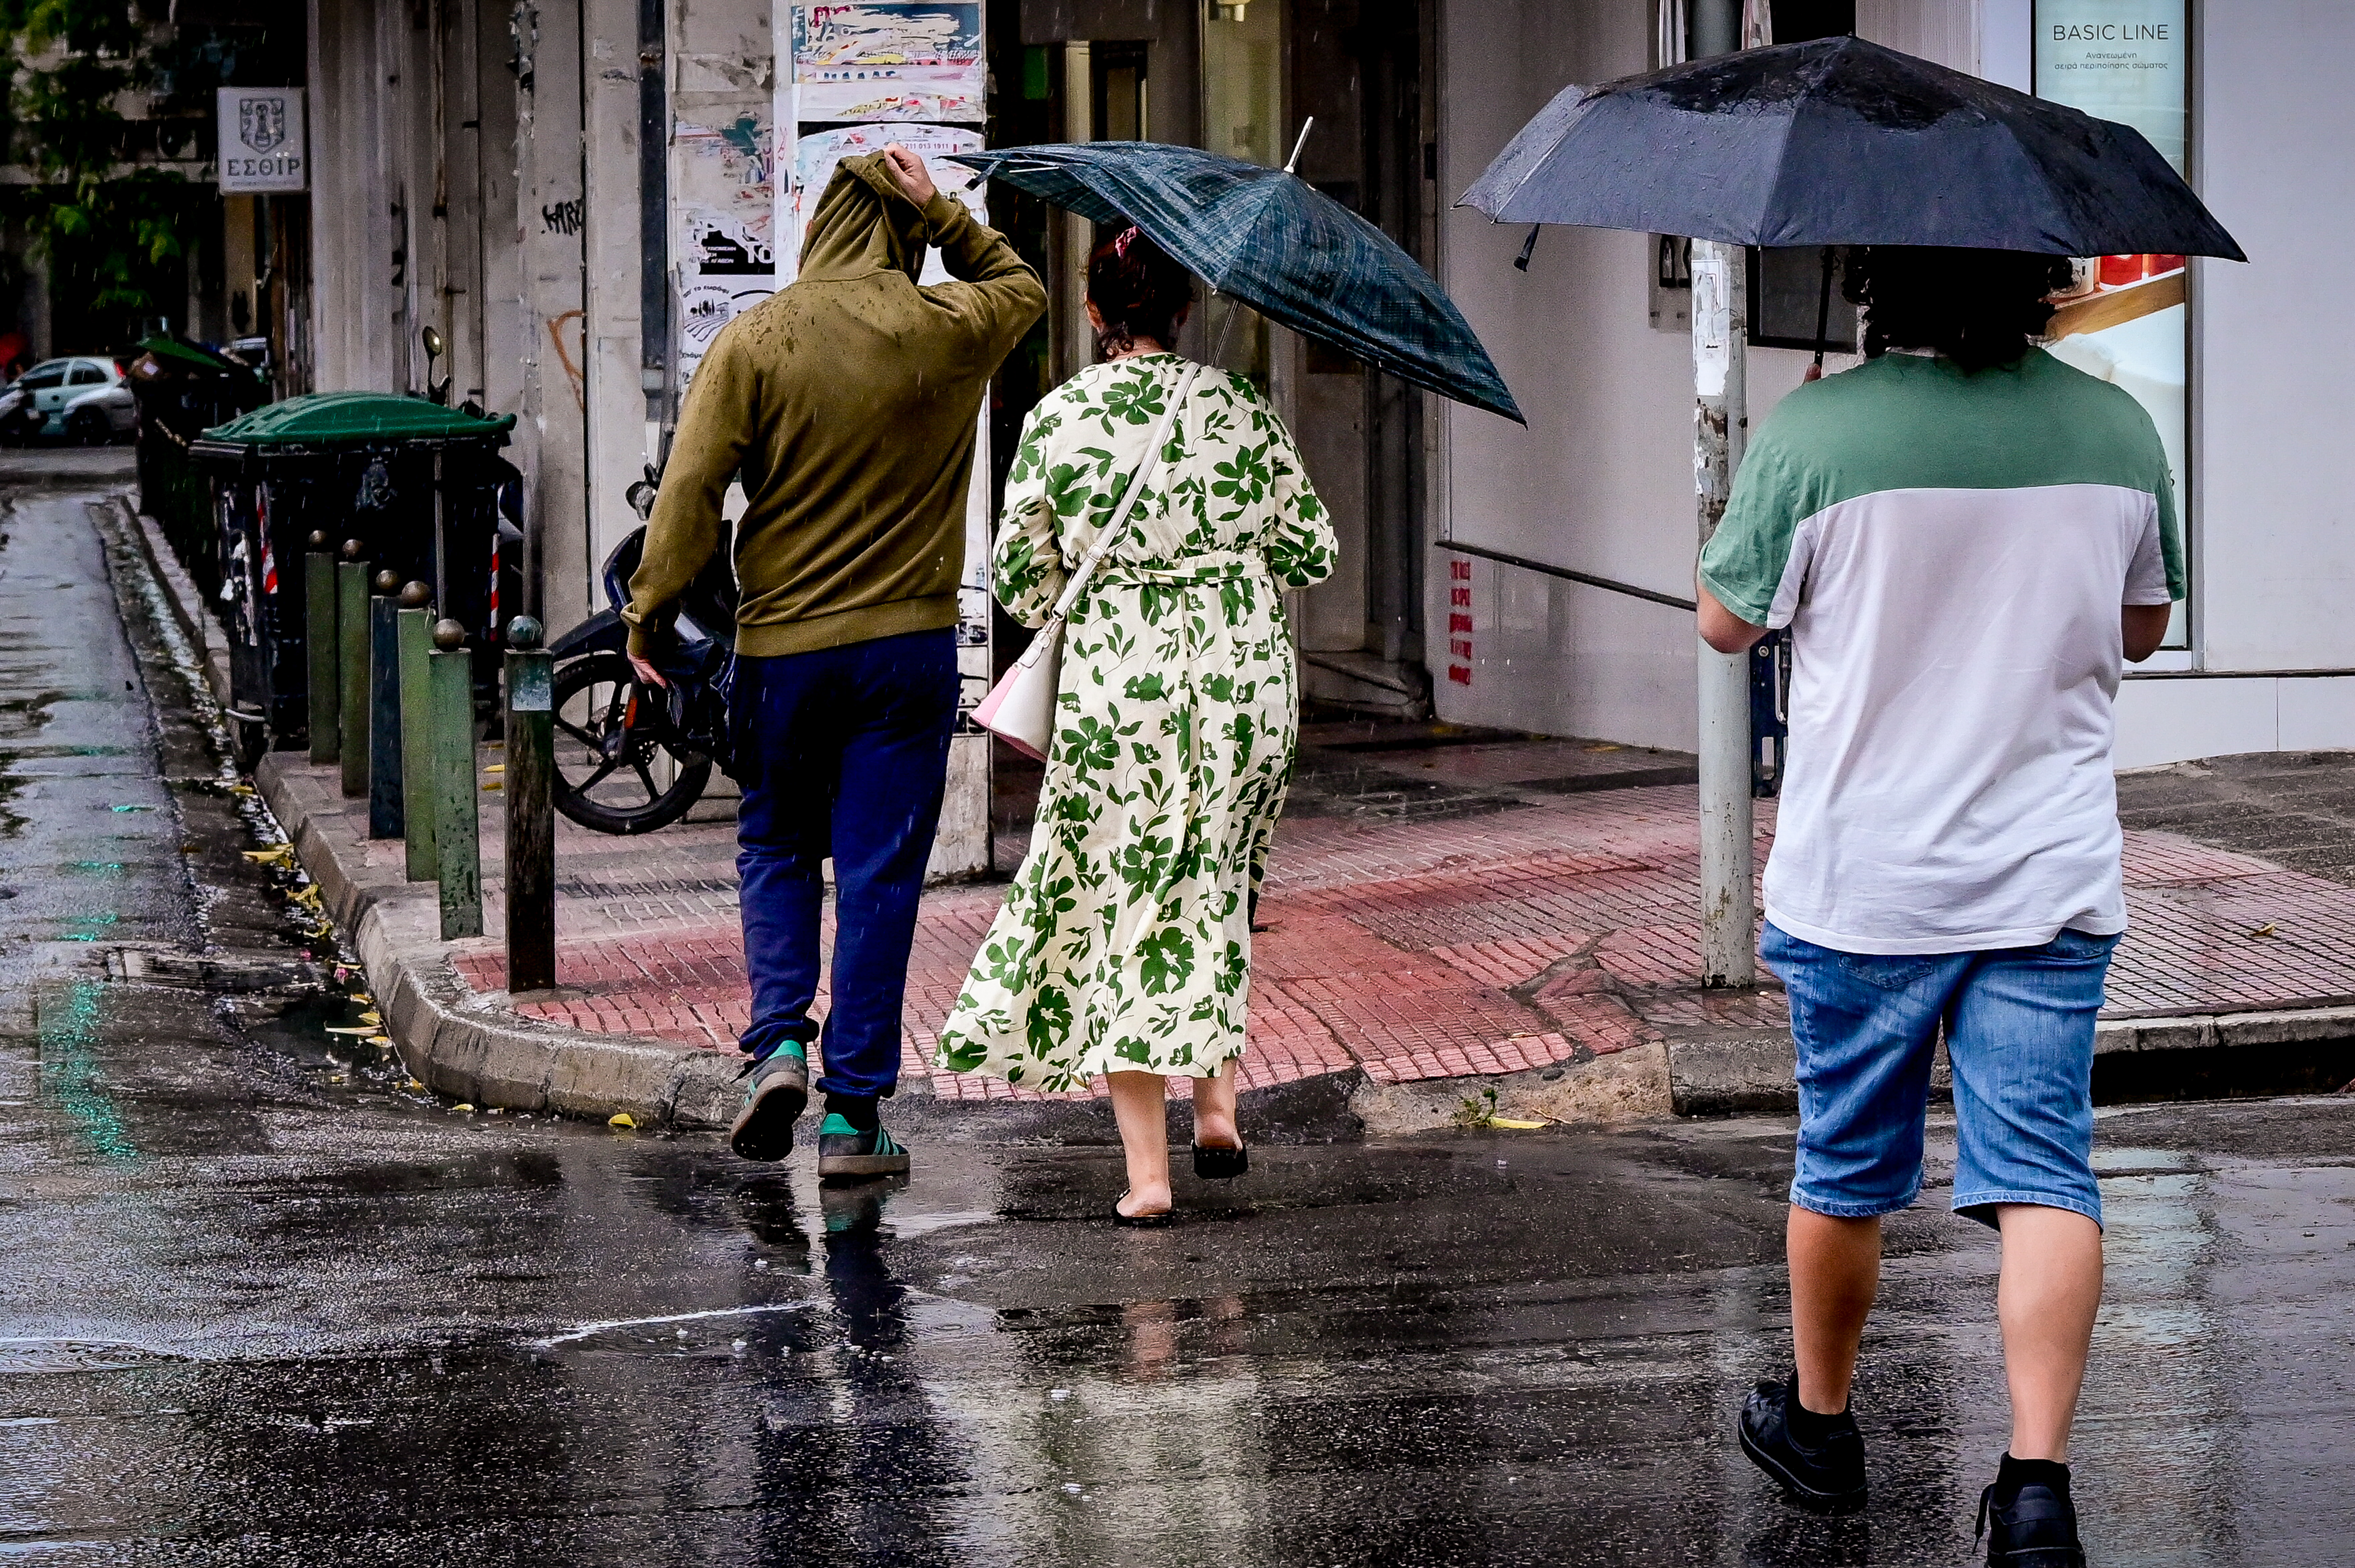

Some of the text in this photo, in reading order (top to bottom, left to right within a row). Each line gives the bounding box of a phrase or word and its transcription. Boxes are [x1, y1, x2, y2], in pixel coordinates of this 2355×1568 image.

[2054, 24, 2168, 40] BASIC LINE
[2054, 62, 2077, 70] σειρά
[2132, 61, 2168, 70] σώματος
